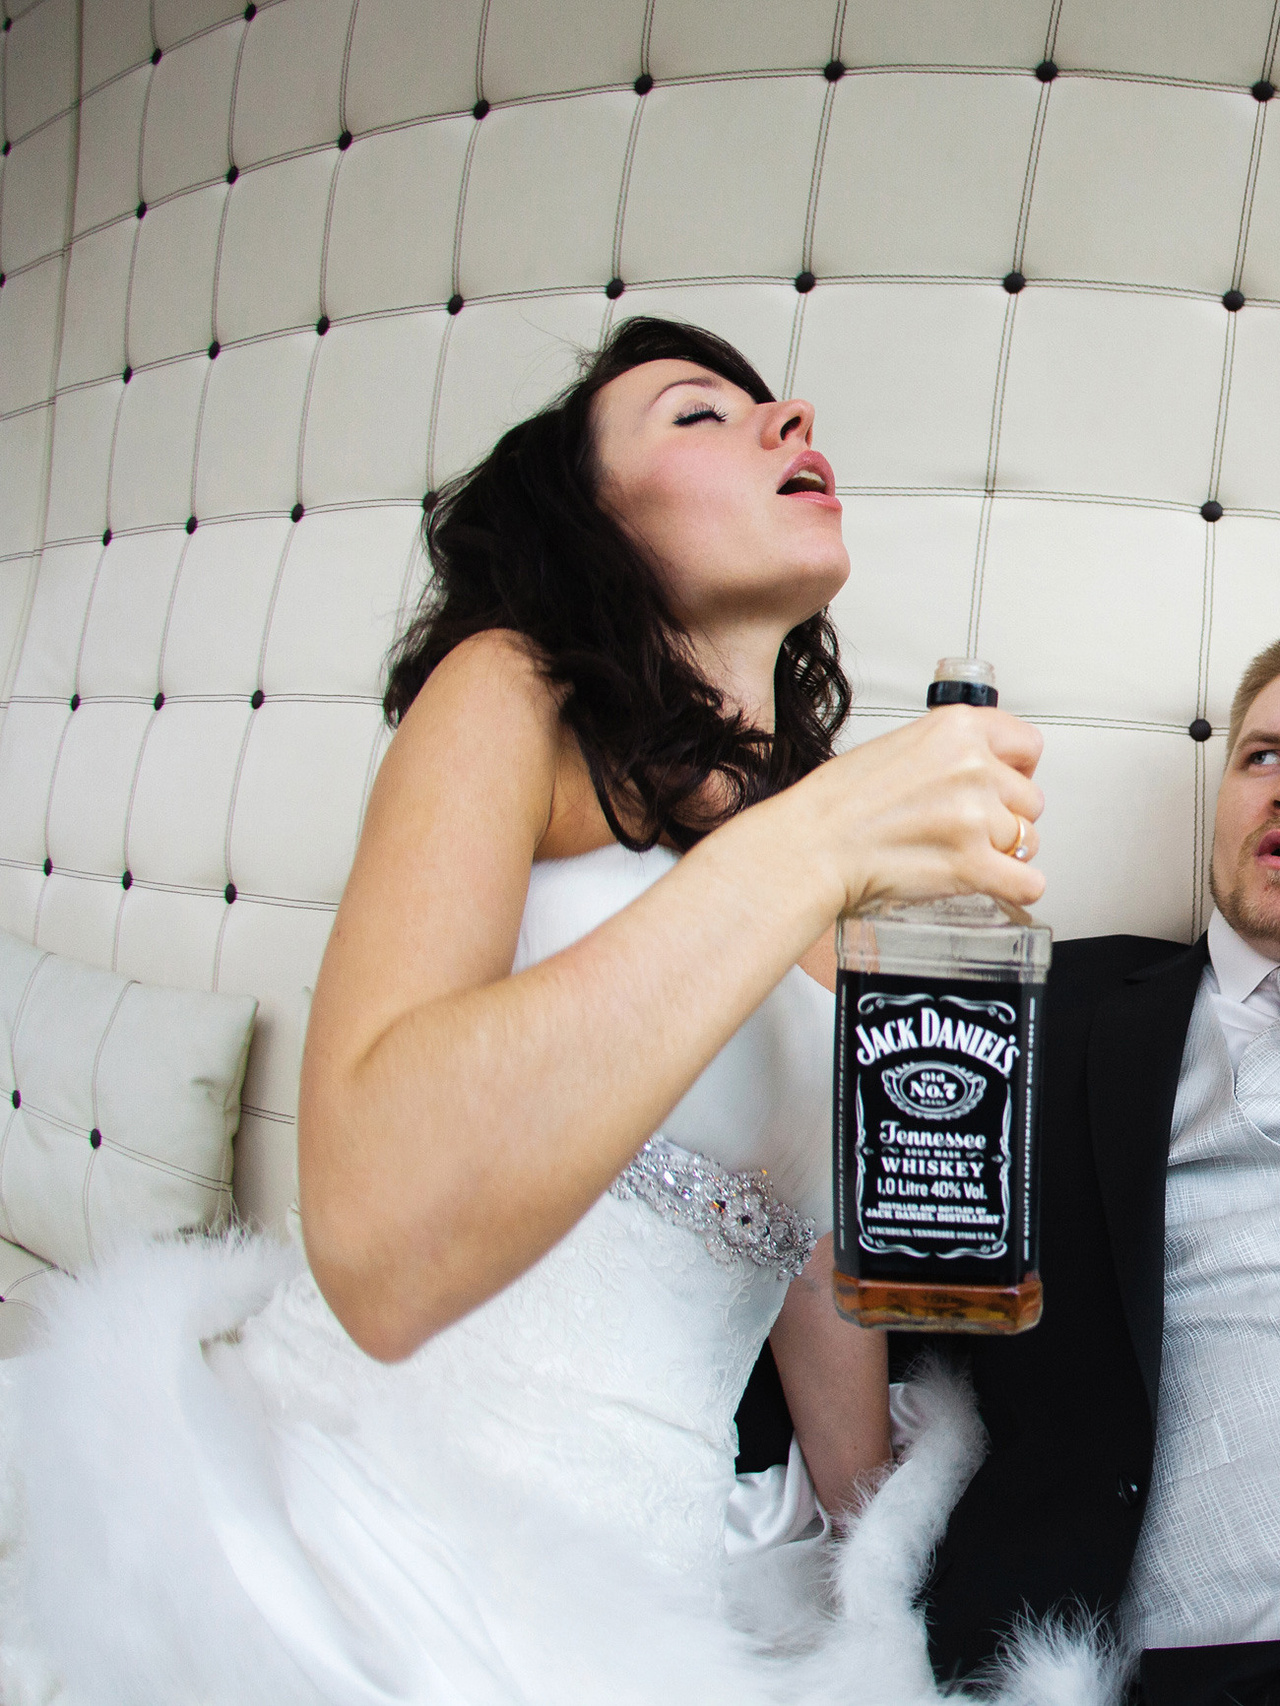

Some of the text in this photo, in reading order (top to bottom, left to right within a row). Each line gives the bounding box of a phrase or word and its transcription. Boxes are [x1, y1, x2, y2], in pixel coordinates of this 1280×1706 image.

[855, 1007, 1021, 1078] JACK DANIEL'S
[920, 1072, 945, 1082] Old
[879, 1121, 986, 1149] Tennessee
[881, 1156, 984, 1178] WHISKEY
[877, 1177, 988, 1200] 1.0 Litre 40% Vol.
[865, 1208, 1001, 1225] JACK DANIEL DISTILLERY
